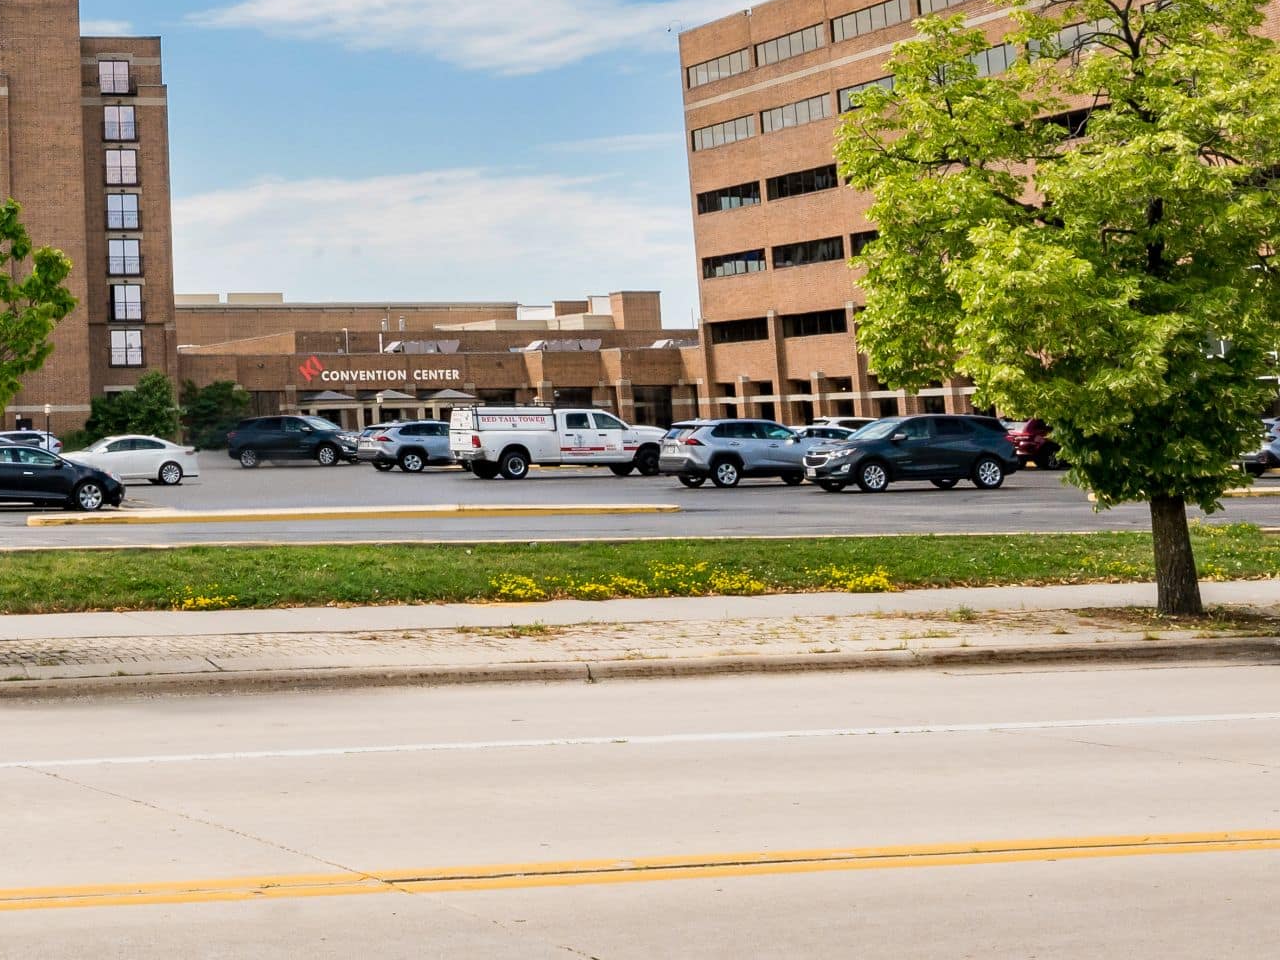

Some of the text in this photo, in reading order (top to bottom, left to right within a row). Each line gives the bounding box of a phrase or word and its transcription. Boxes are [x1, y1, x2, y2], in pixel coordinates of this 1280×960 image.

[299, 355, 459, 382] KI CONVENTION CENTER
[518, 416, 545, 424] TOWER
